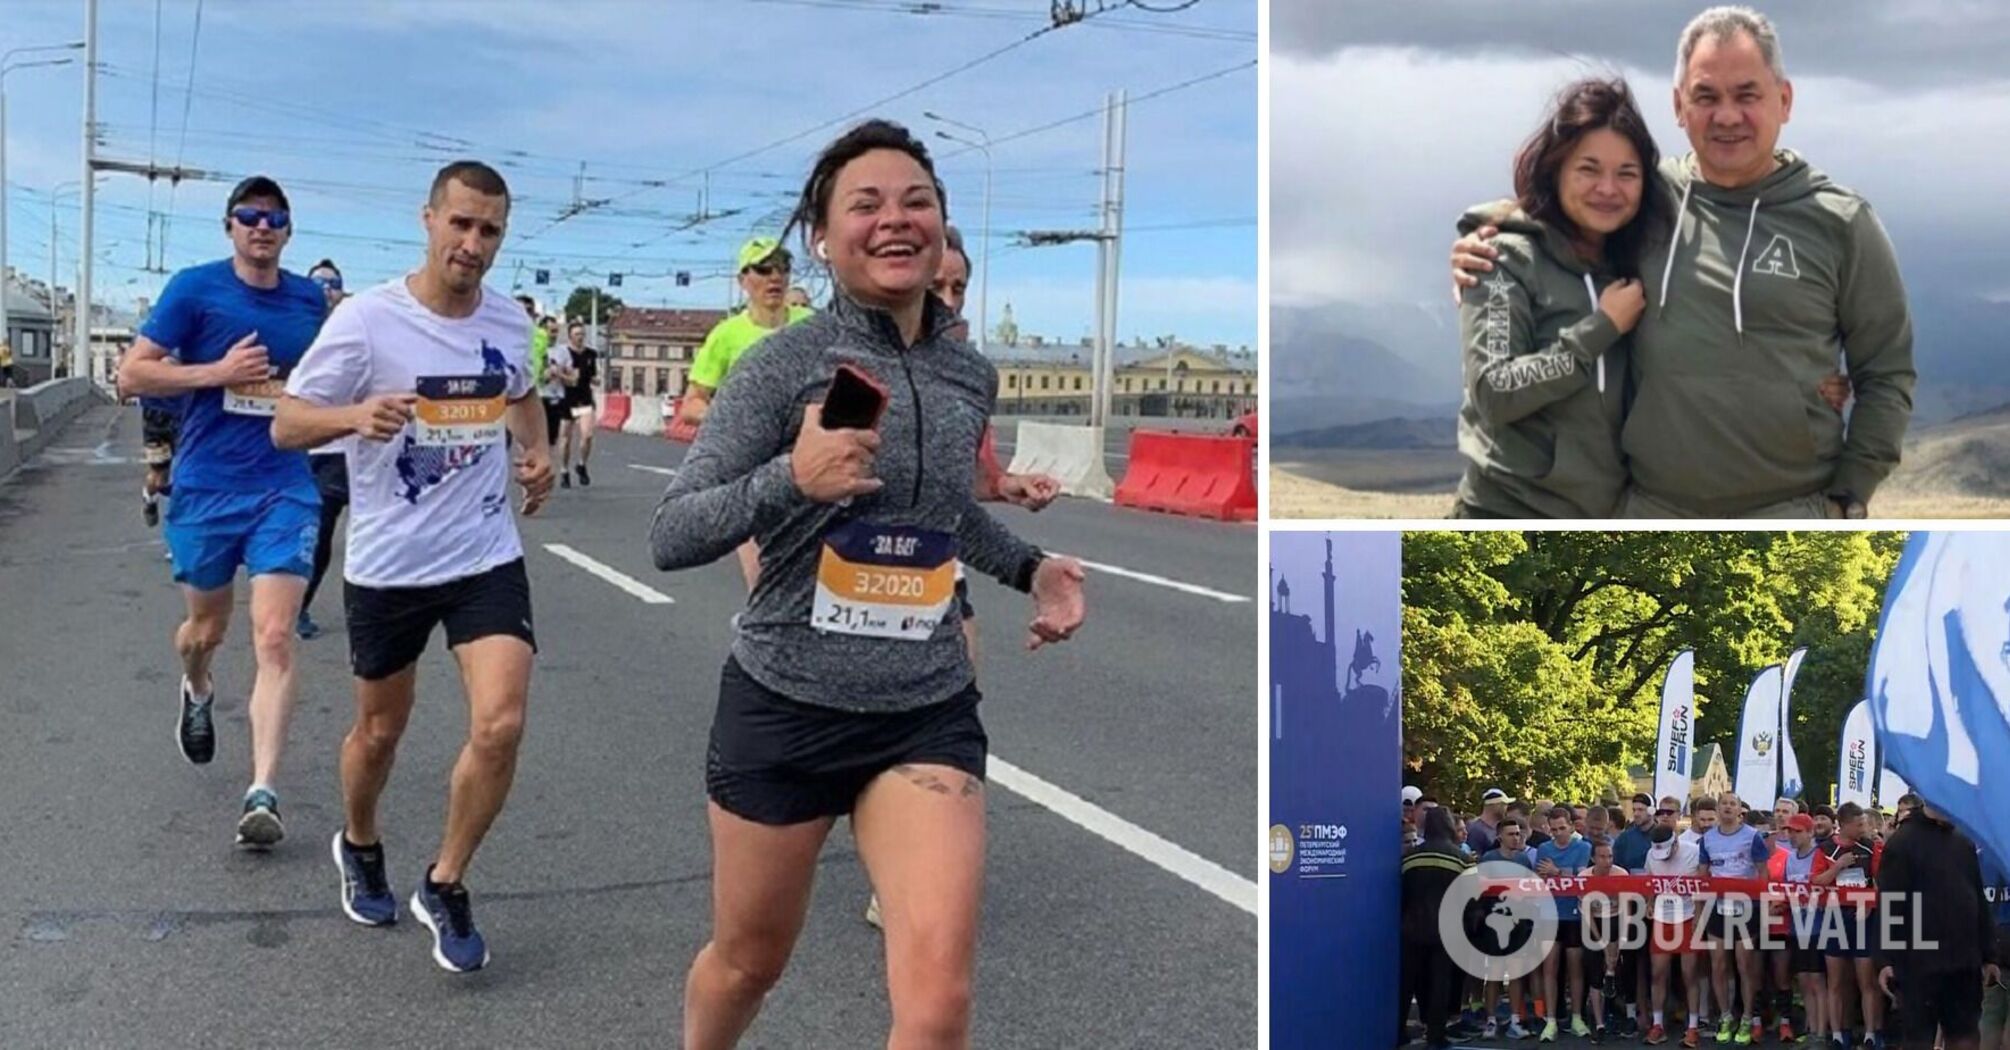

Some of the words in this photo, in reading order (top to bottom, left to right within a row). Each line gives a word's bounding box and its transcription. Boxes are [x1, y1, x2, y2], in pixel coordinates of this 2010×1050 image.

[1752, 234, 1800, 279] А
[440, 405, 487, 420] 32019
[874, 535, 893, 555] ЗА
[855, 572, 925, 598] 32020
[1678, 705, 1689, 746] RUN
[1667, 718, 1681, 772] SPIEF
[1856, 739, 1866, 770] RUN
[1849, 750, 1857, 791] SPIEF
[1314, 824, 1347, 839] ПМЭФ
[1518, 878, 1588, 891] СТАРТ
[1767, 881, 1840, 898] СТАРТ
